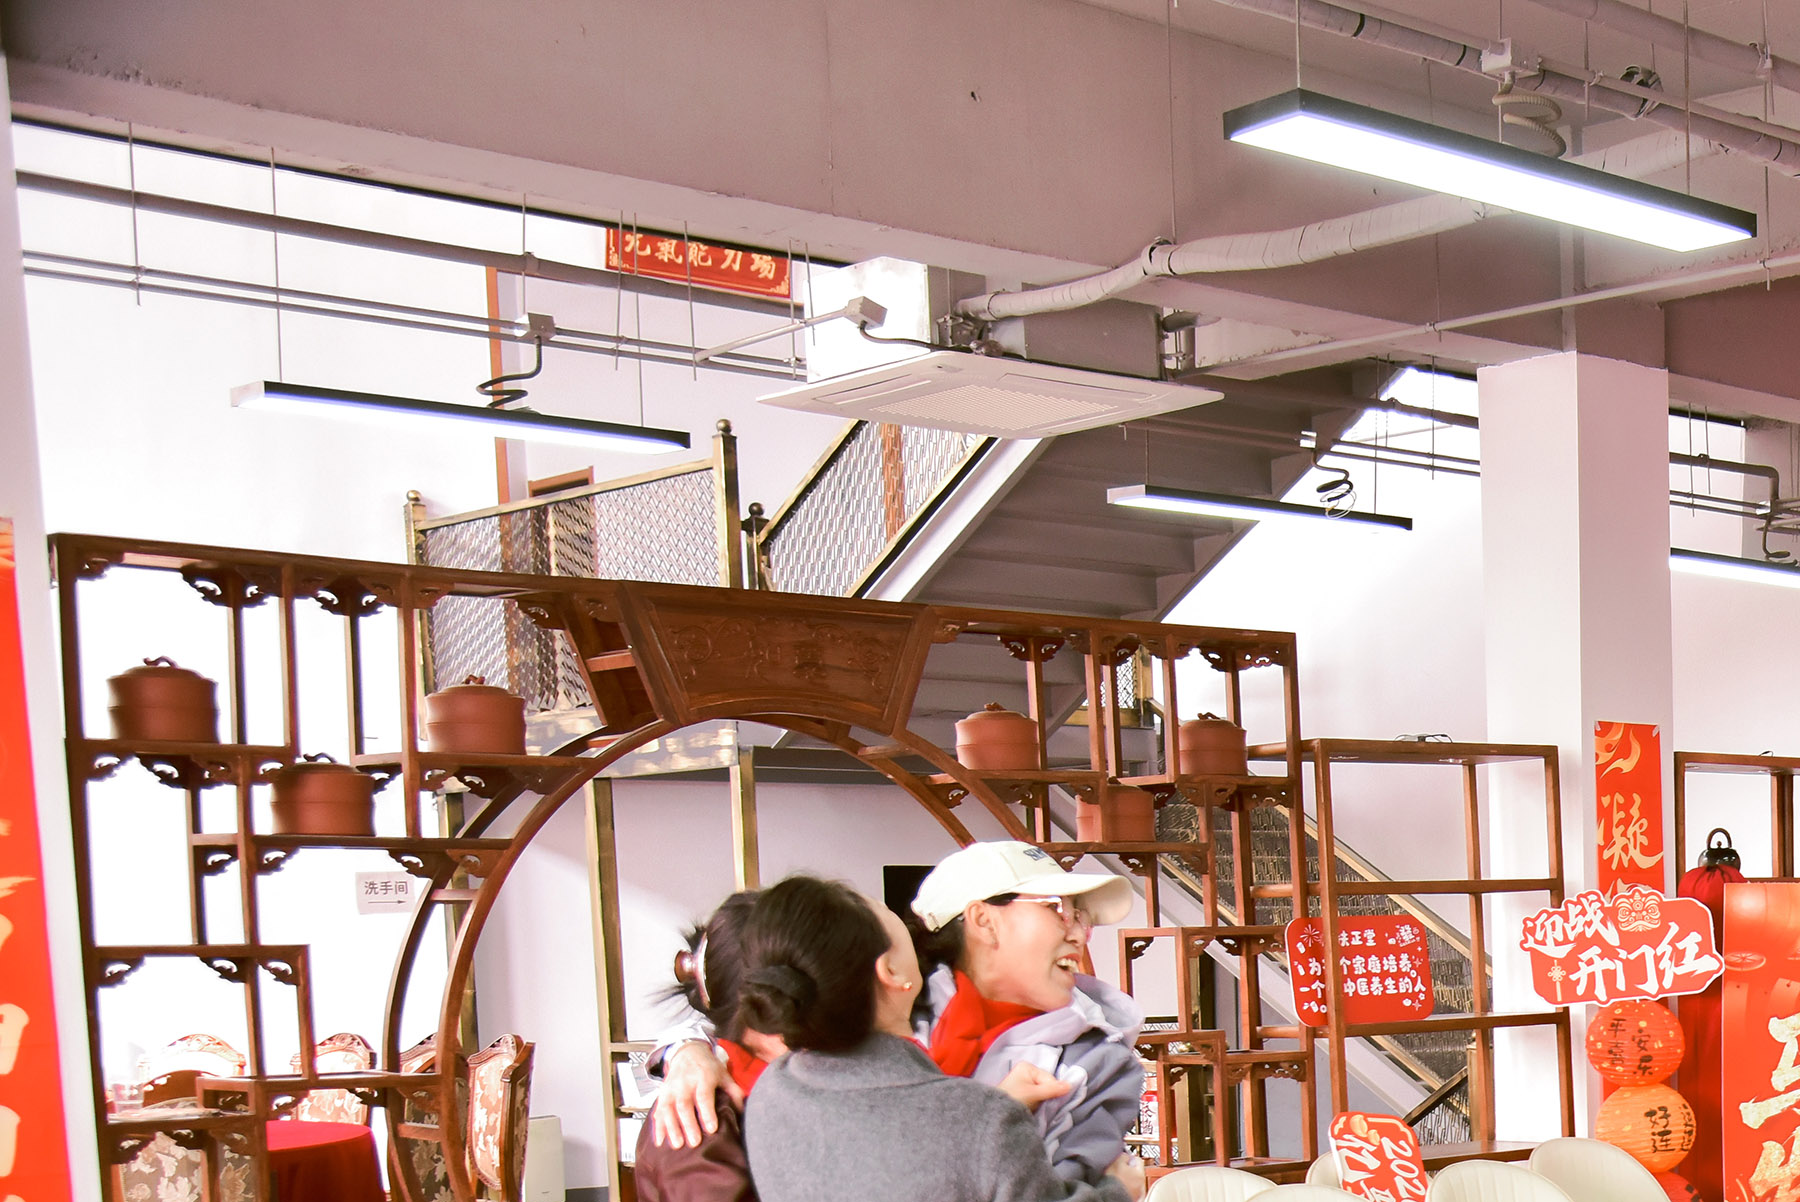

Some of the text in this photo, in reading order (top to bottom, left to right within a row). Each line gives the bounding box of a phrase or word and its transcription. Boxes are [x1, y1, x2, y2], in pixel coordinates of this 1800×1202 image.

[1597, 792, 1664, 900] 凝
[364, 881, 408, 895] 洗手间
[1524, 895, 1620, 958] 迎战
[1308, 953, 1412, 976] 为个家庭培养
[1569, 922, 1720, 996] 开门红
[1299, 975, 1426, 998] 一个中医养生的人
